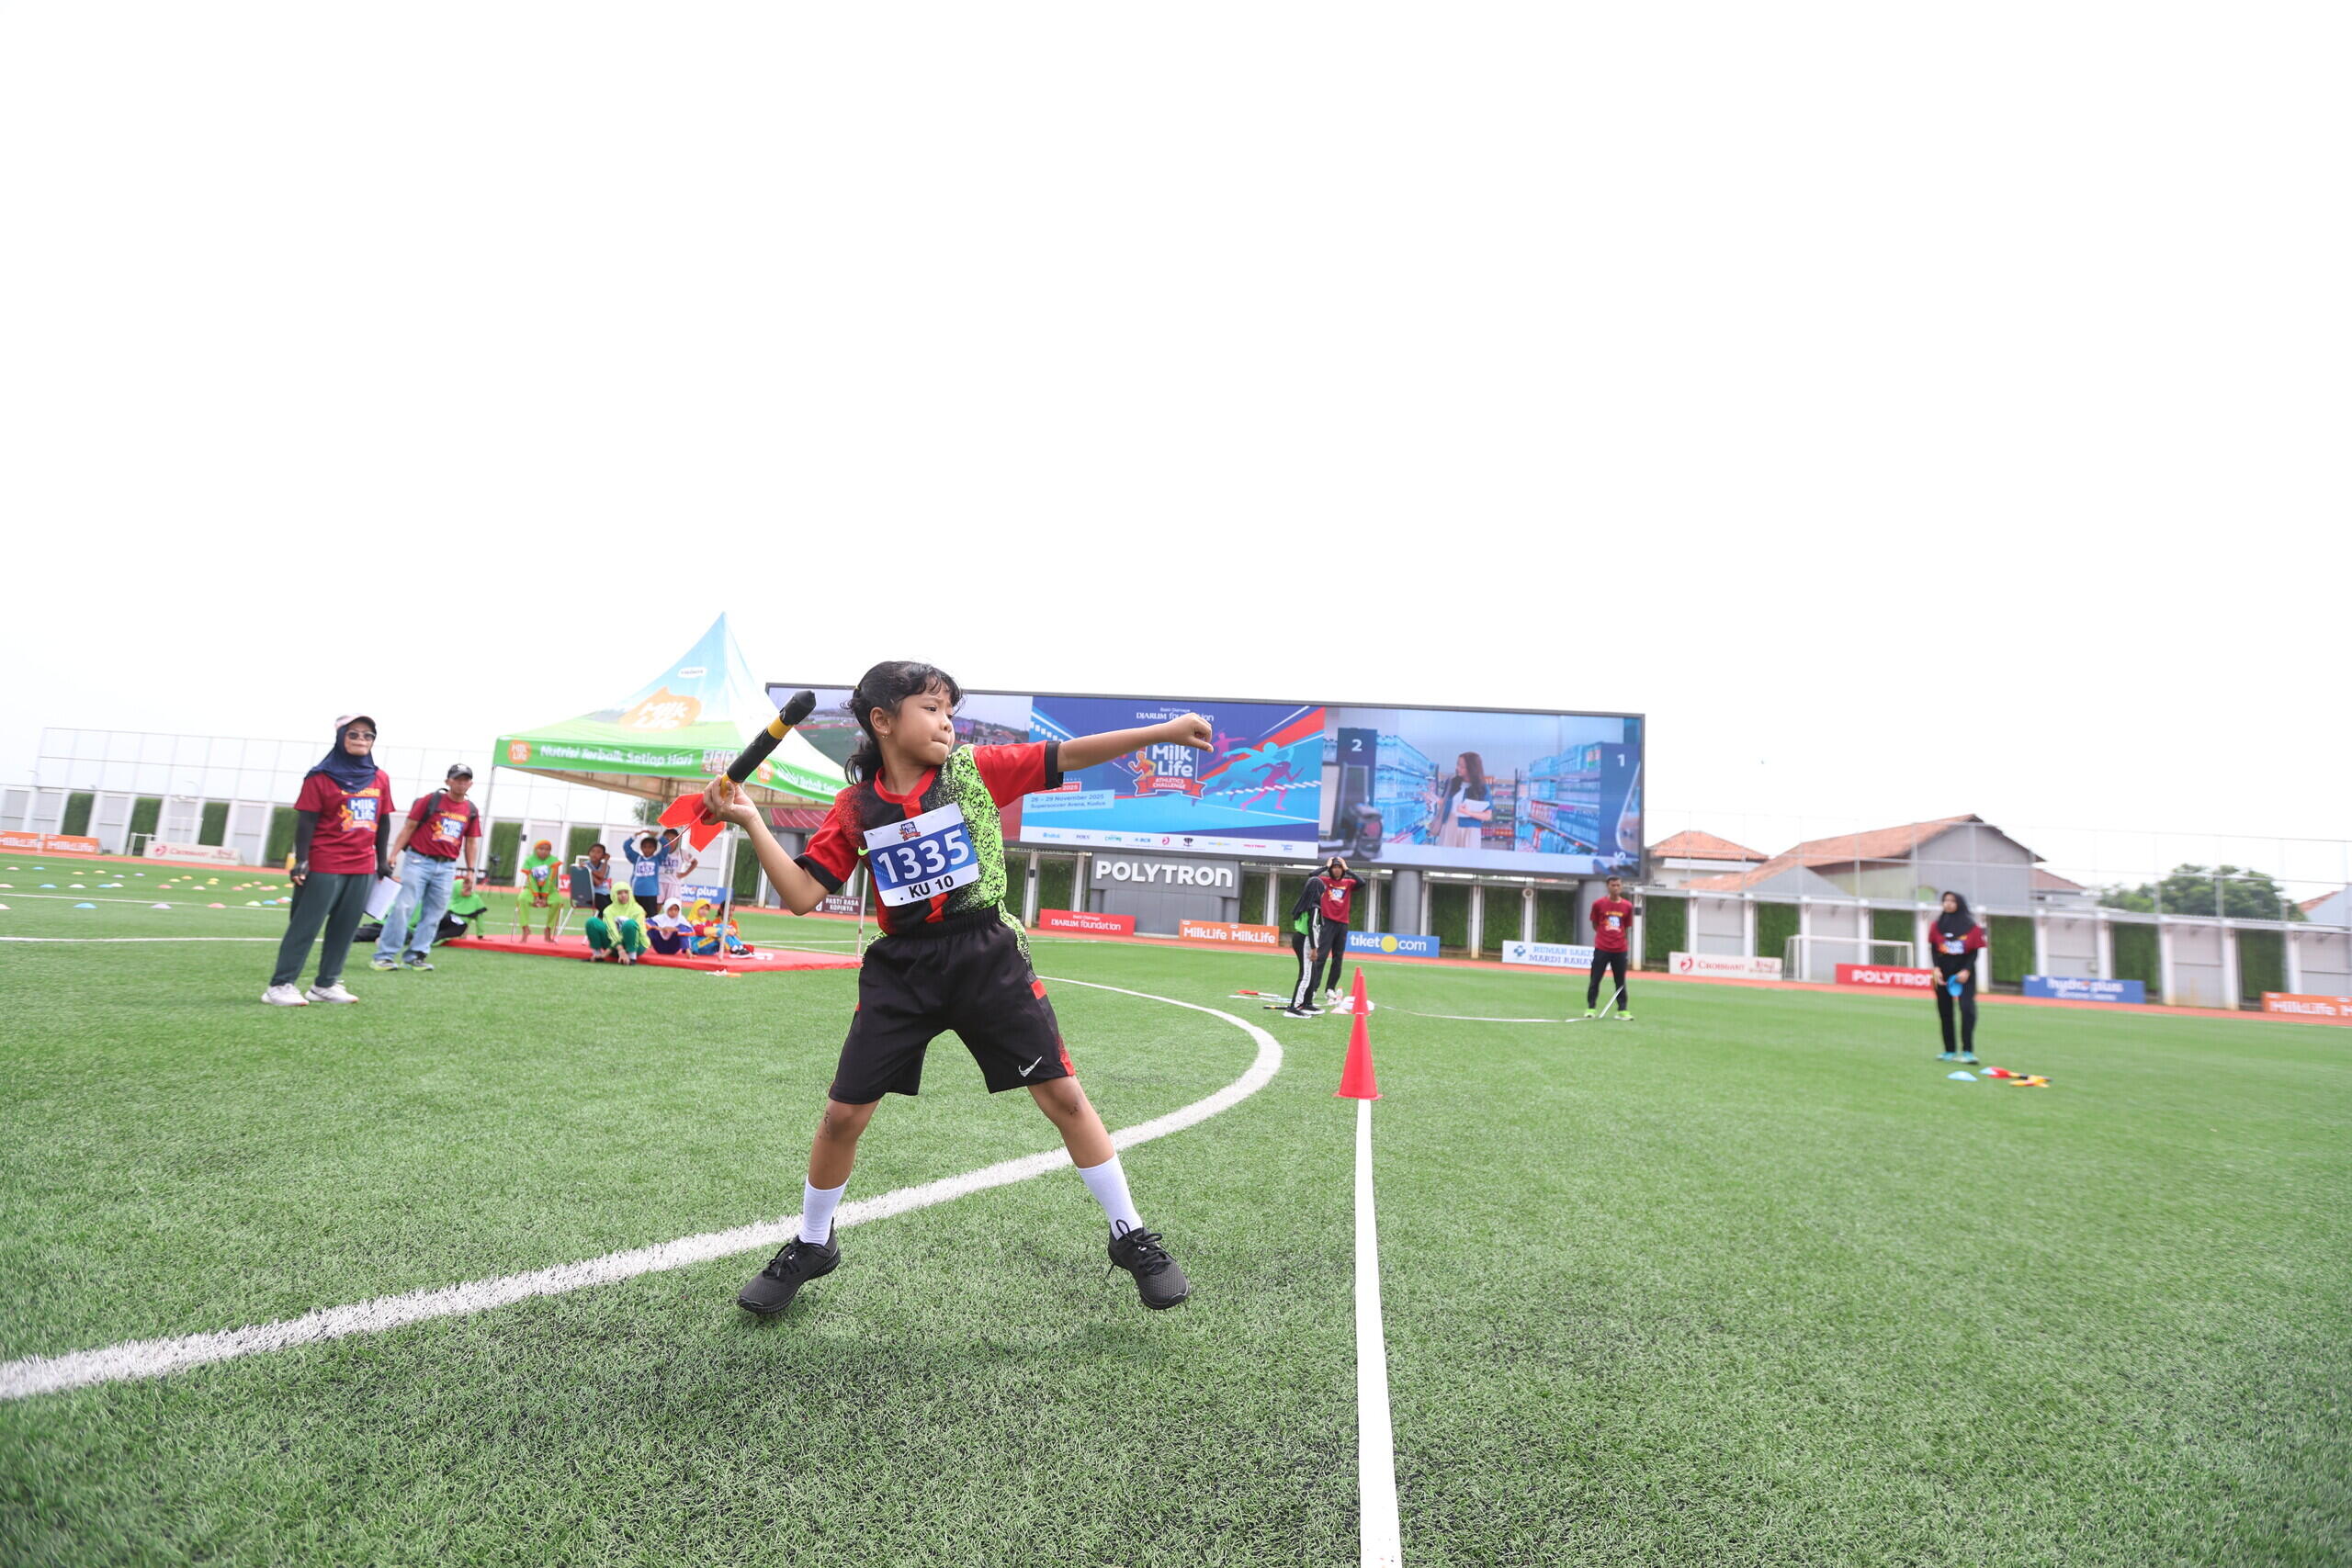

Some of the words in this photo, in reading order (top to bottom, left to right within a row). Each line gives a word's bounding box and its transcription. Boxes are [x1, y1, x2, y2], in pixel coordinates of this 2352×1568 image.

[1152, 745, 1193, 761] Milk
[1351, 739, 1363, 751] 2
[540, 745, 580, 759] Nutrisi
[582, 749, 623, 762] Terbaik
[627, 750, 665, 768] Setiap
[667, 753, 693, 766] Hari
[1617, 754, 1625, 767] 1
[1158, 761, 1193, 777] Life
[876, 829, 969, 884] 1335
[1095, 860, 1233, 888] POLYTRON
[696, 886, 718, 897] plus
[908, 882, 931, 898] KU
[934, 875, 954, 890] 10
[1080, 919, 1122, 931] foundation
[1183, 927, 1227, 940] MilkLife
[1231, 931, 1276, 943] MilkLife
[1529, 954, 1561, 963] MARDI
[1532, 946, 1567, 955] RUMAH
